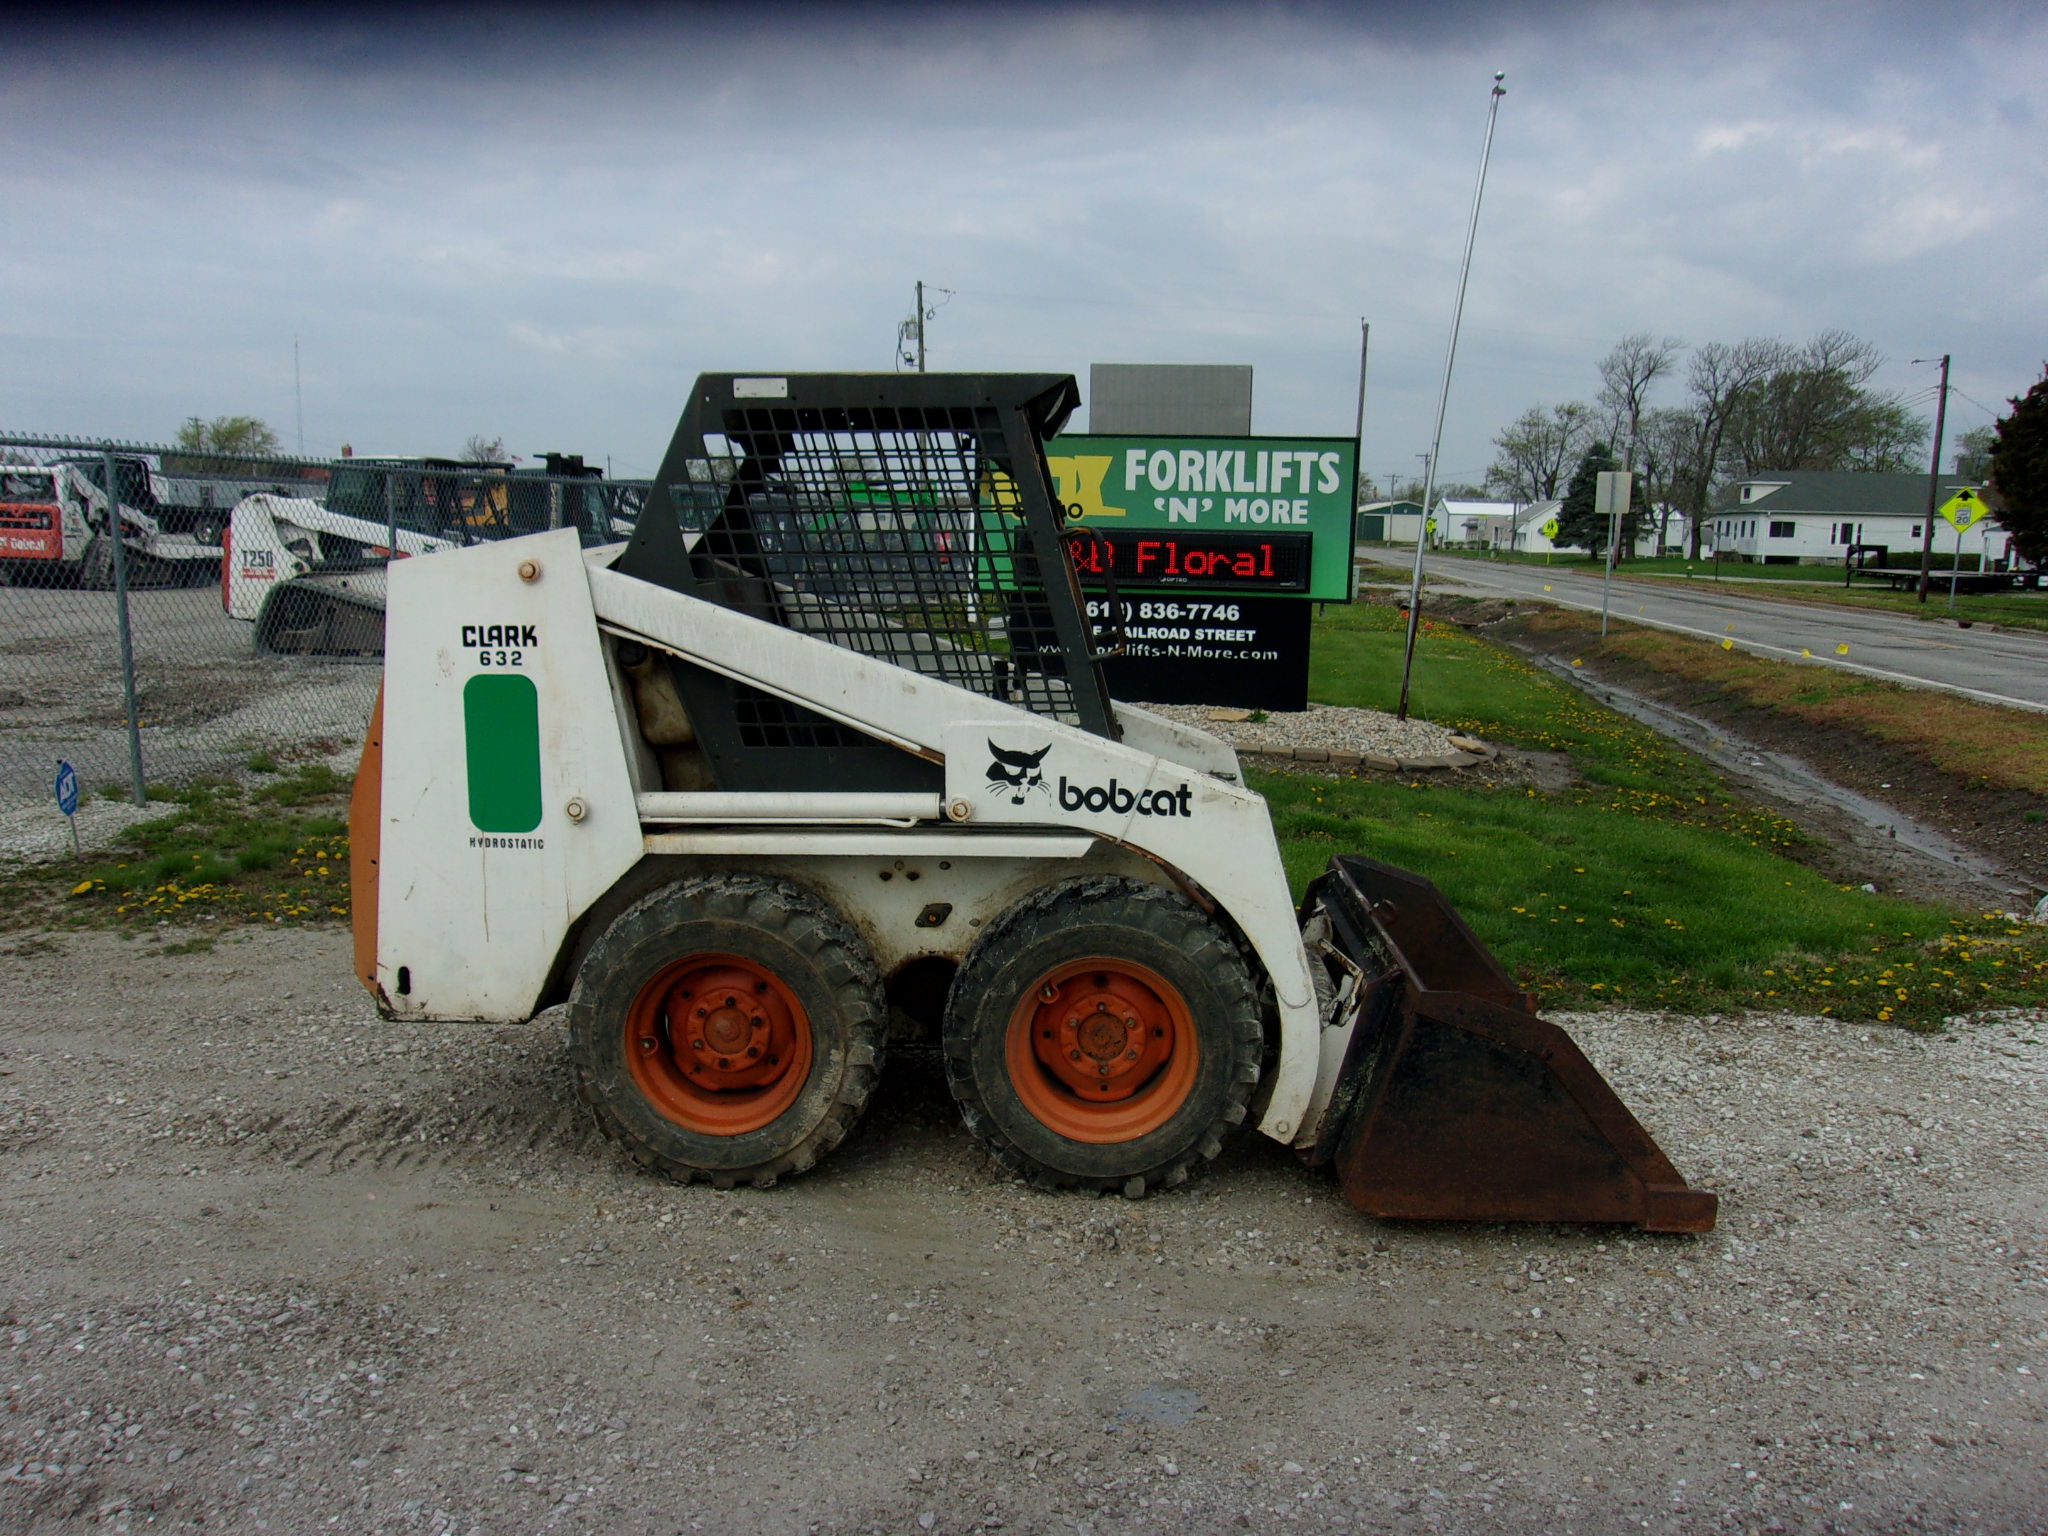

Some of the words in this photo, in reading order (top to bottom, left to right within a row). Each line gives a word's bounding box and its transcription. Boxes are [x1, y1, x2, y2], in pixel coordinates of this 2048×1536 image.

[1125, 449, 1340, 494] FORKLIFTS
[1224, 498, 1309, 524] MORE
[1956, 516, 1969, 524] 20
[241, 549, 274, 567] T250
[1137, 541, 1275, 576] Floral
[1139, 602, 1240, 621] 836-7746
[462, 624, 538, 647] CLARK
[1112, 626, 1190, 640] AILROAD
[1194, 628, 1256, 642] STREET
[480, 650, 522, 666] 632
[1059, 776, 1192, 817] bobcat
[469, 837, 544, 849] HYDROSTATIC
